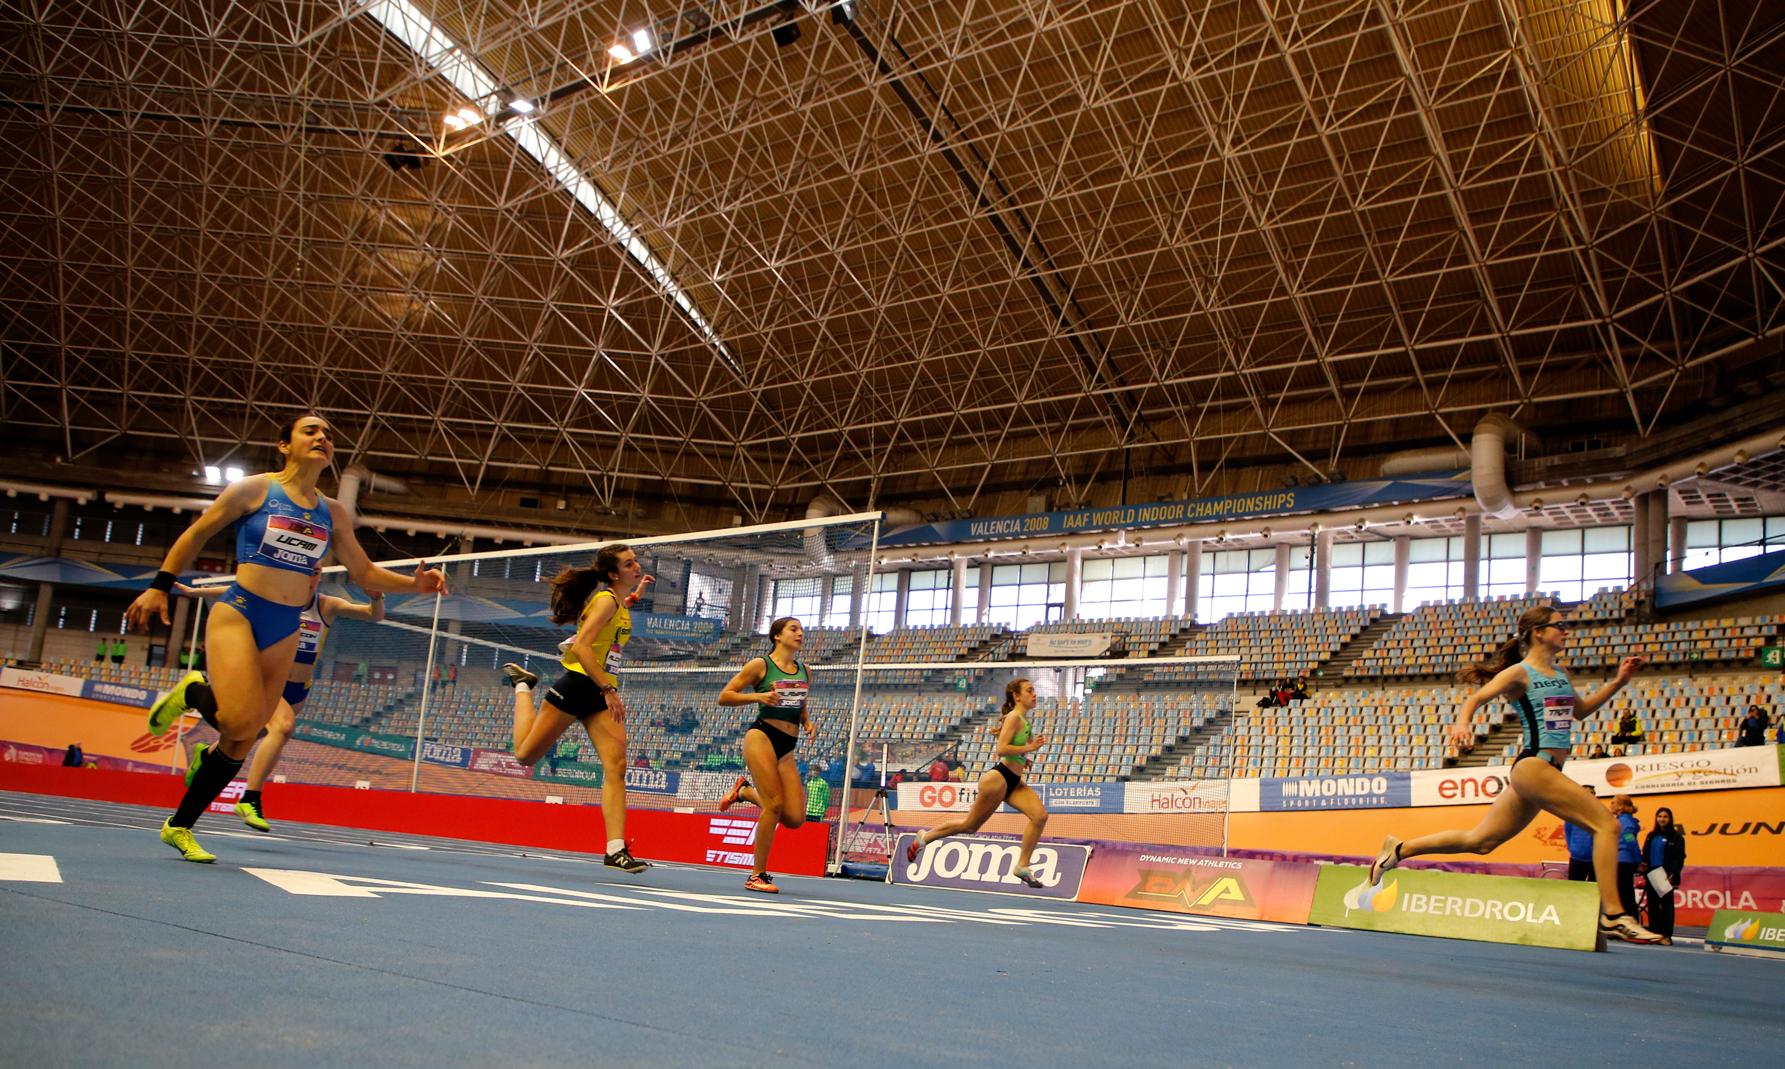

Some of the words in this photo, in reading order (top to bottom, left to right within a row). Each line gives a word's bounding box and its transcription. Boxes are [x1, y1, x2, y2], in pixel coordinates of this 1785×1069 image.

[1063, 513, 1090, 529] IAAF
[1092, 510, 1136, 527] WORLD
[1138, 505, 1185, 523] INDOOR
[1187, 492, 1296, 518] CHAMPIONSHIPS
[970, 518, 1021, 537] VALENCIA
[1023, 516, 1050, 533] 2008
[276, 534, 318, 552] UCAM
[646, 617, 691, 631] VALENCIA
[1635, 759, 1712, 773] RIESGO
[624, 770, 668, 789] oma
[1300, 777, 1388, 798] MONDO
[1139, 854, 1177, 865] DYNAMIC
[1177, 856, 1197, 866] NEW
[1197, 858, 1243, 869] ATHLETICS
[1401, 892, 1561, 926] IBERDROLA
[1673, 889, 1759, 911] DROLA
